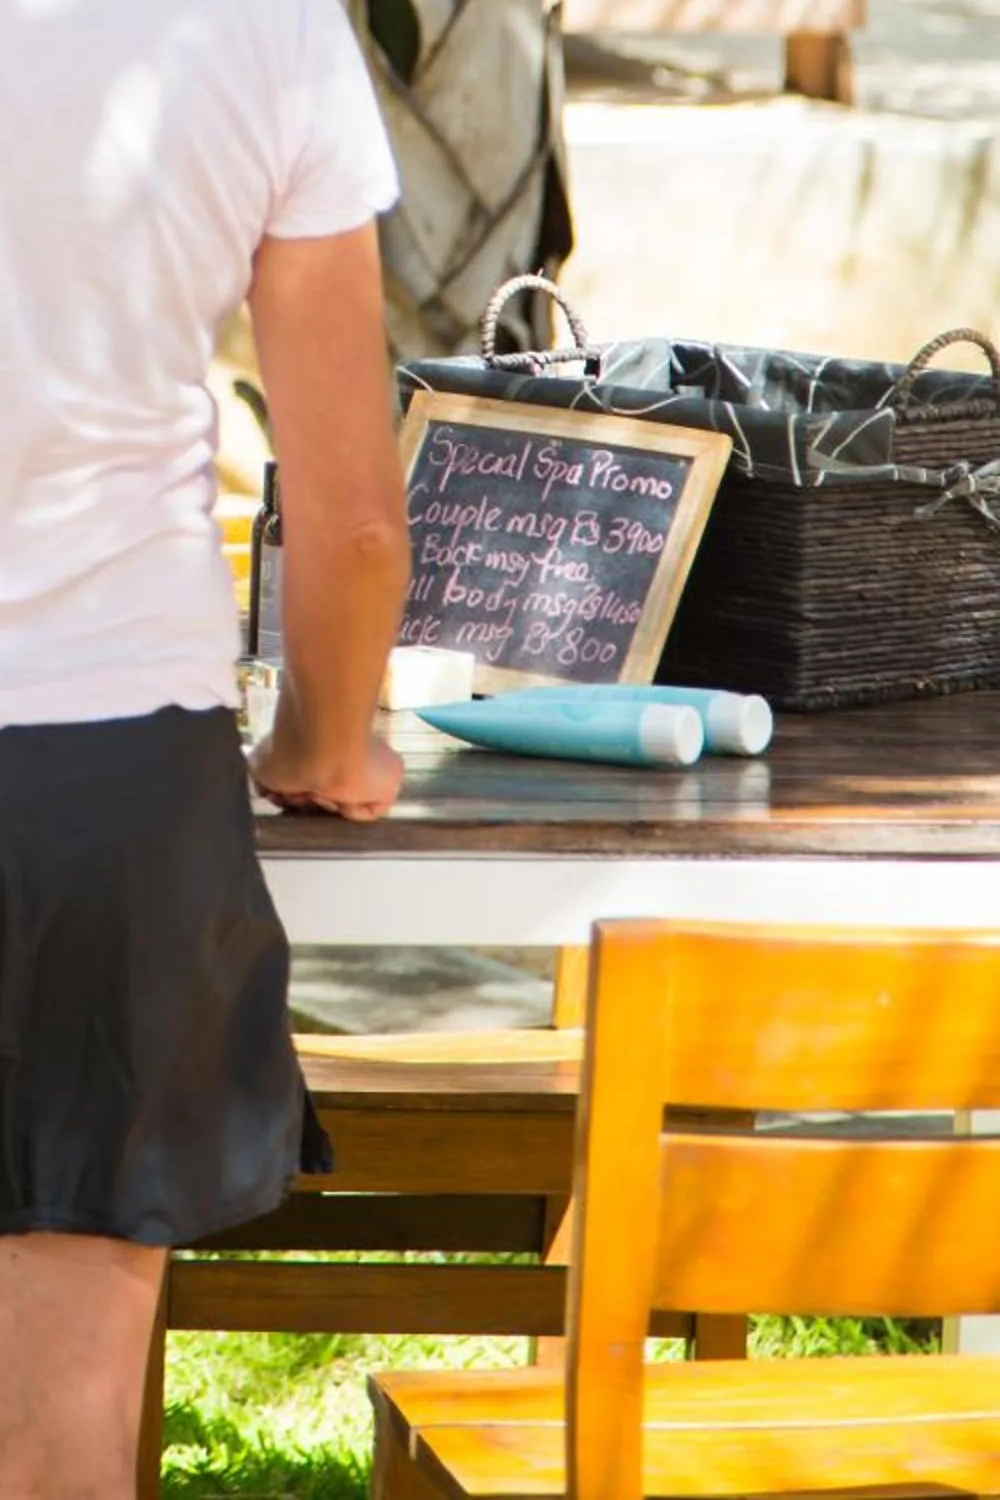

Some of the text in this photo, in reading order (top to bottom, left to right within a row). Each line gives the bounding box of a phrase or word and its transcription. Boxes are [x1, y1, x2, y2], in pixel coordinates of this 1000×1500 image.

[533, 445, 580, 500] Spa
[588, 449, 673, 499] Promo
[407, 483, 502, 548] Couple
[506, 510, 567, 550] msg
[602, 517, 665, 555] 3900
[420, 532, 483, 568] Back
[484, 551, 531, 587] msg
[442, 567, 518, 624] body
[522, 591, 577, 638] msg
[455, 620, 514, 662] msg
[556, 627, 618, 665] 800
